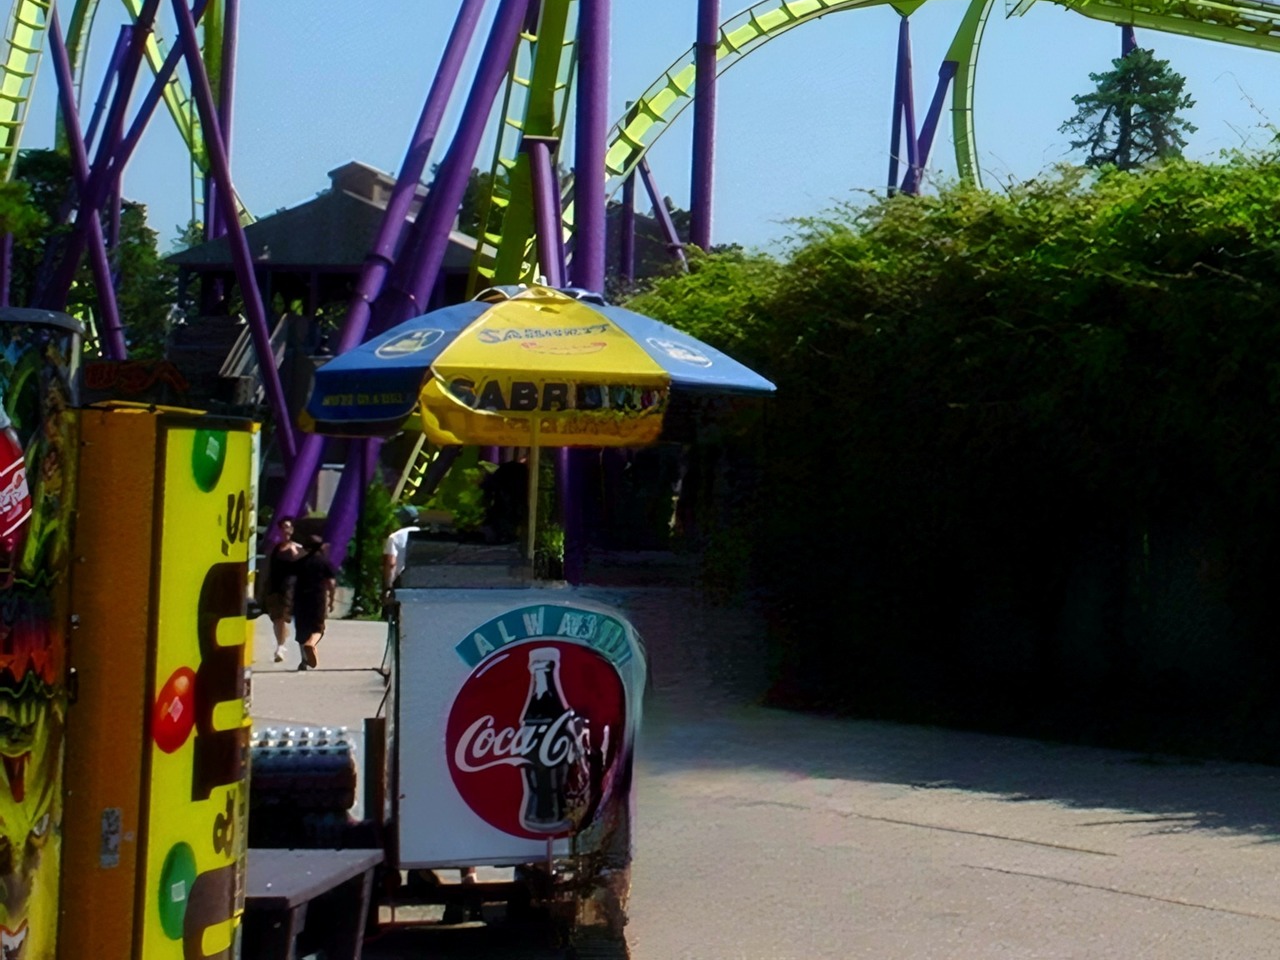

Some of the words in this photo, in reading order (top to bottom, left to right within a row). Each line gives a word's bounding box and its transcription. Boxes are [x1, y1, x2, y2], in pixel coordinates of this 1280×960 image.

[478, 323, 610, 344] SATT
[449, 375, 665, 411] SABR
[473, 606, 632, 667] ALWA
[454, 708, 612, 773] Coca-C
